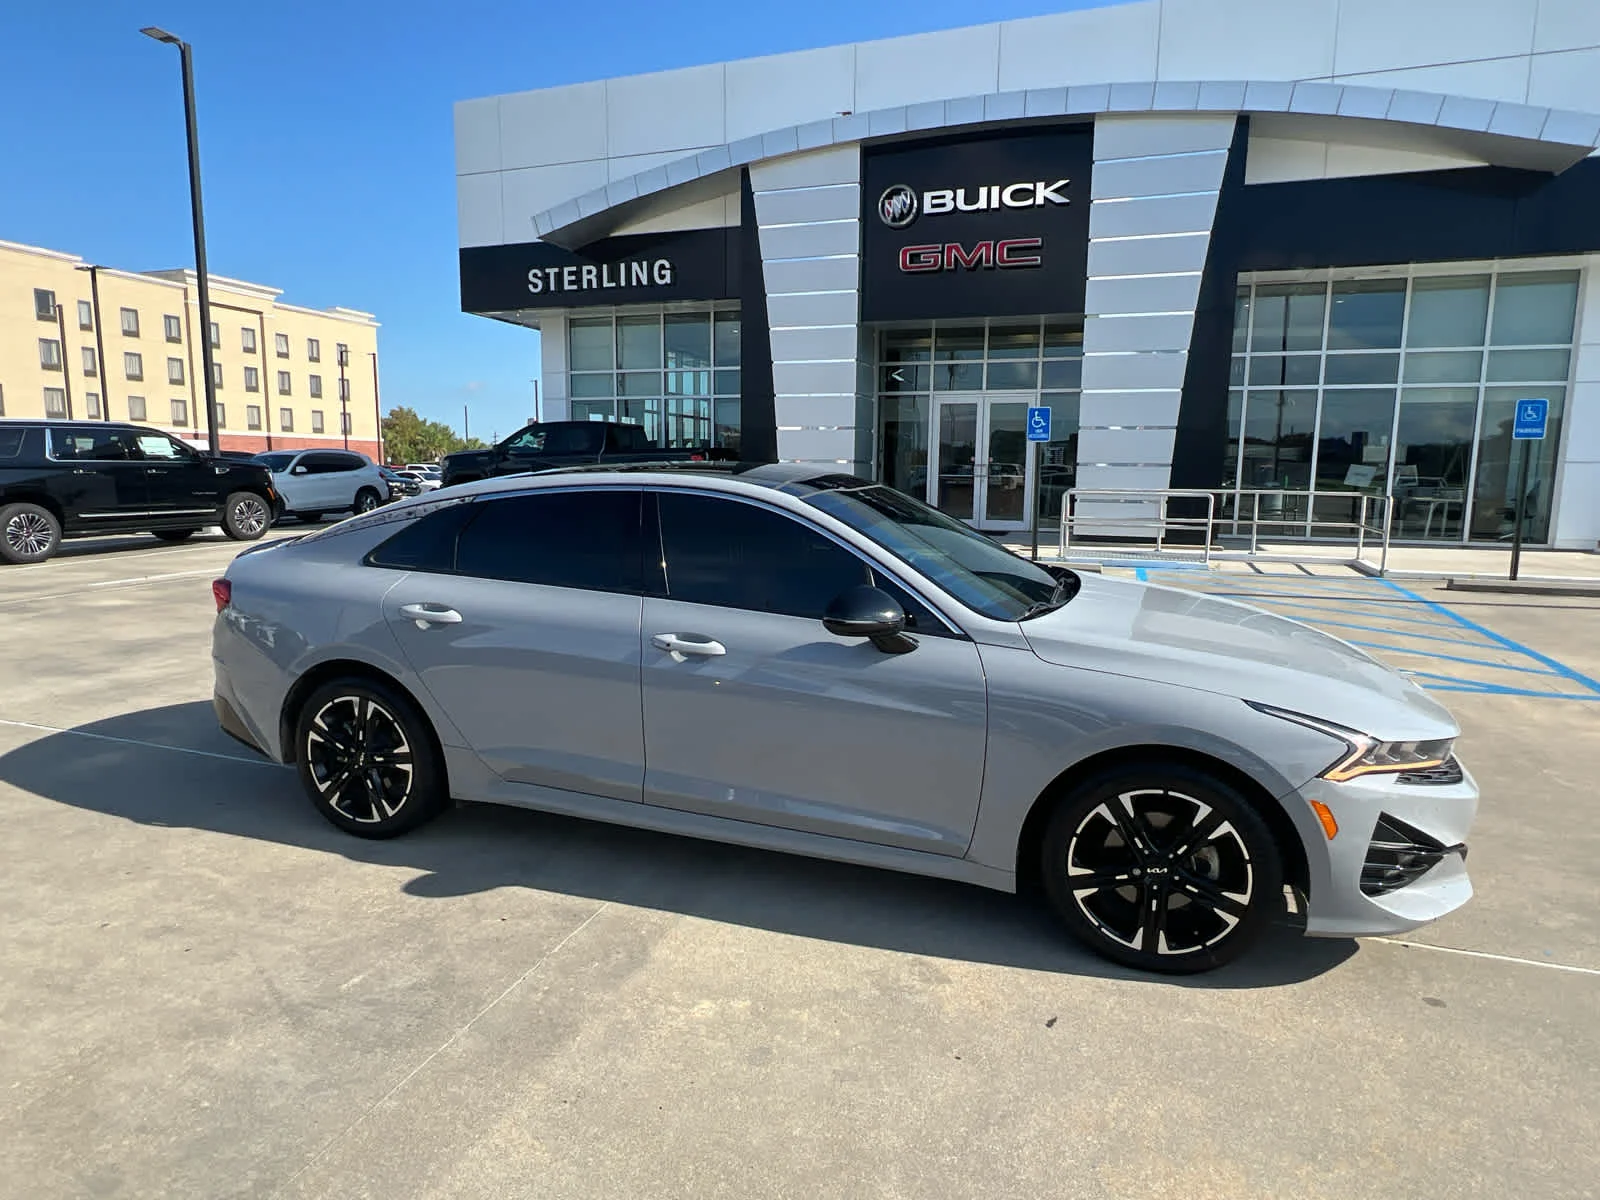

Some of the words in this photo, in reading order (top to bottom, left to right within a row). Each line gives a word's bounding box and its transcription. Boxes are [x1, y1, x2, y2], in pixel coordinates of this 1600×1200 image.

[923, 179, 1071, 214] BUICK
[899, 237, 1042, 272] GMC
[527, 258, 672, 293] STERLING
